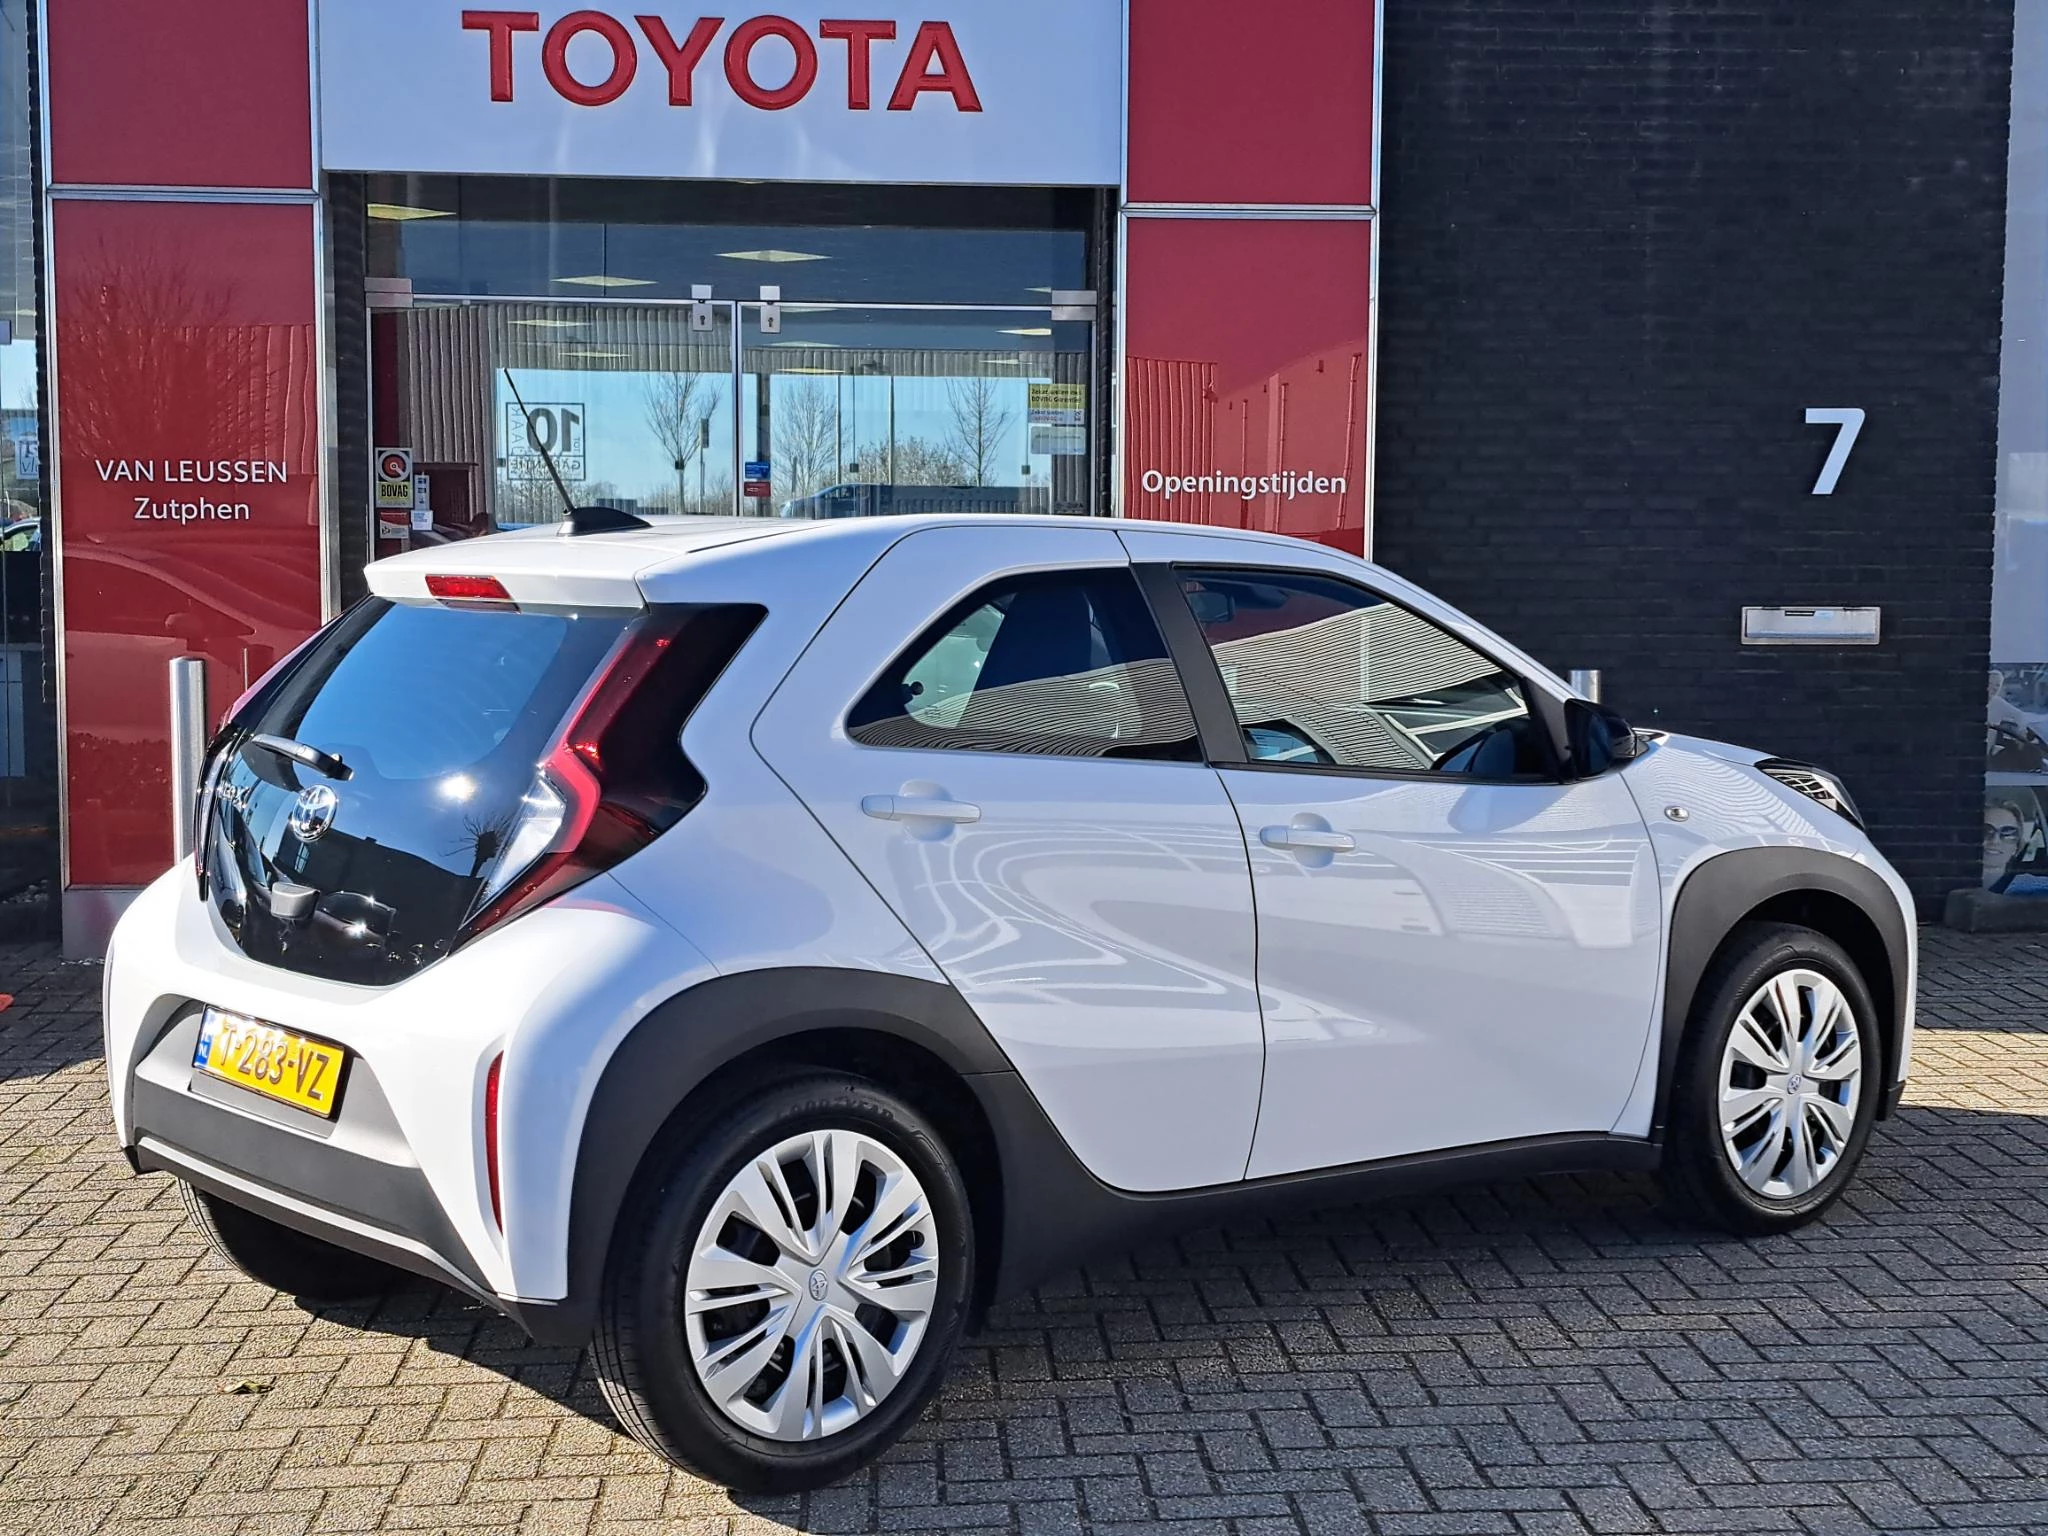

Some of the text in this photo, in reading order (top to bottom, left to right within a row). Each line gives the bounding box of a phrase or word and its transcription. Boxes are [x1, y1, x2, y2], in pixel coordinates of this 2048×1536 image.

[461, 10, 983, 112] TOYOTA
[1805, 408, 1866, 495] 7
[95, 460, 288, 483] VAN LEUSSEN
[1142, 470, 1347, 501] Openingstijden
[381, 485, 408, 497] BOVAG
[134, 497, 250, 525] Zutphen
[220, 1024, 330, 1101] T-283-VZ
